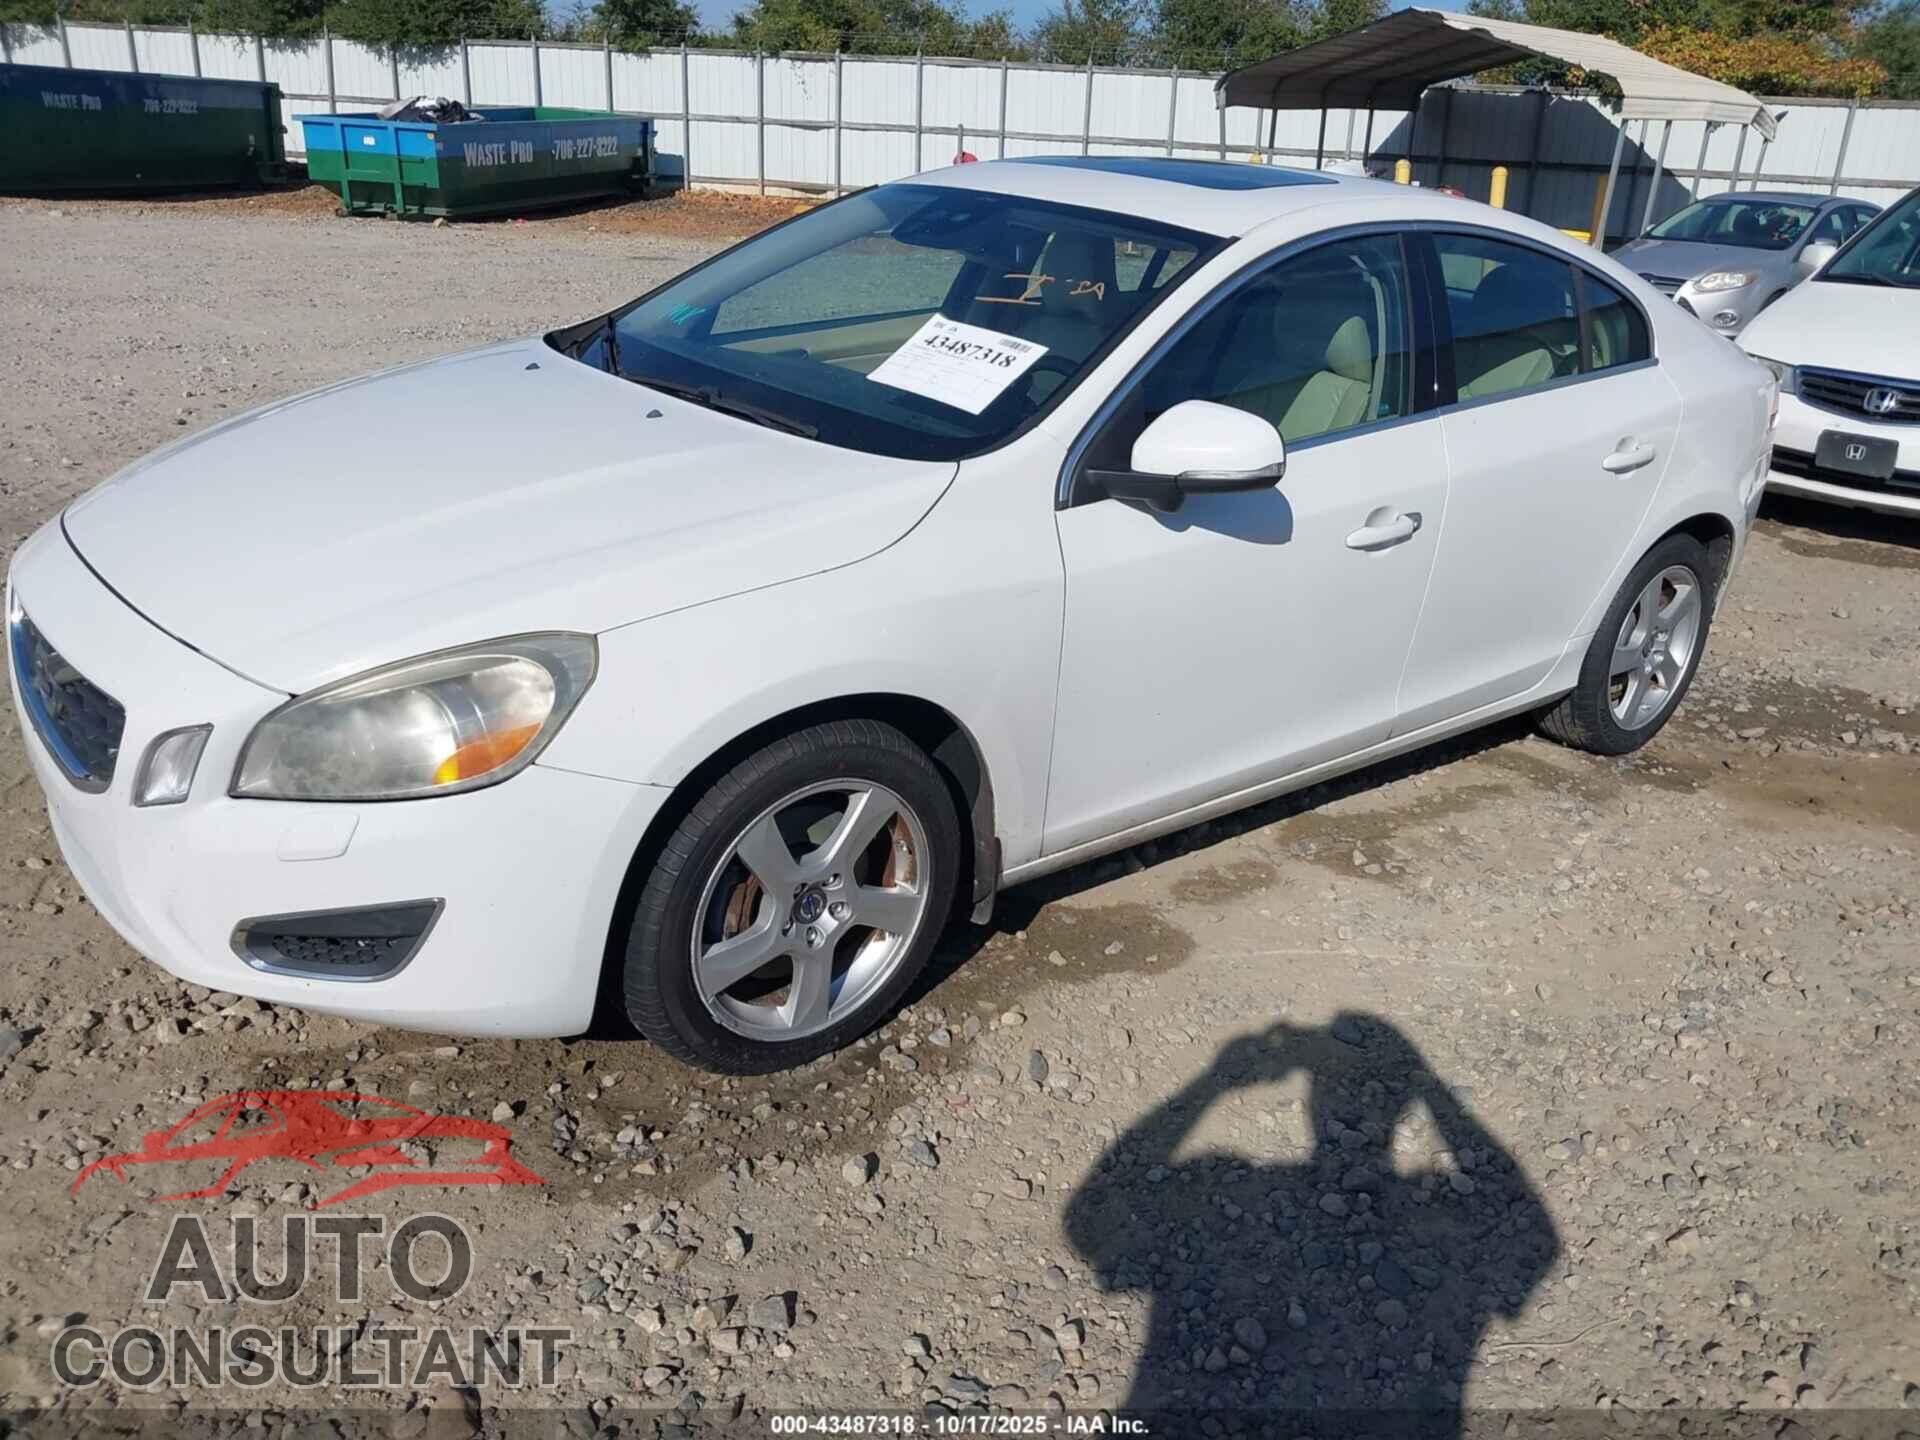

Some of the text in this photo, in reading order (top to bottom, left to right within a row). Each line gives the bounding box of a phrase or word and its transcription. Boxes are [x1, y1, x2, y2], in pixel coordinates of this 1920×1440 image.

[463, 139, 534, 168] WASTE PRO
[923, 335, 1017, 368] 43487318
